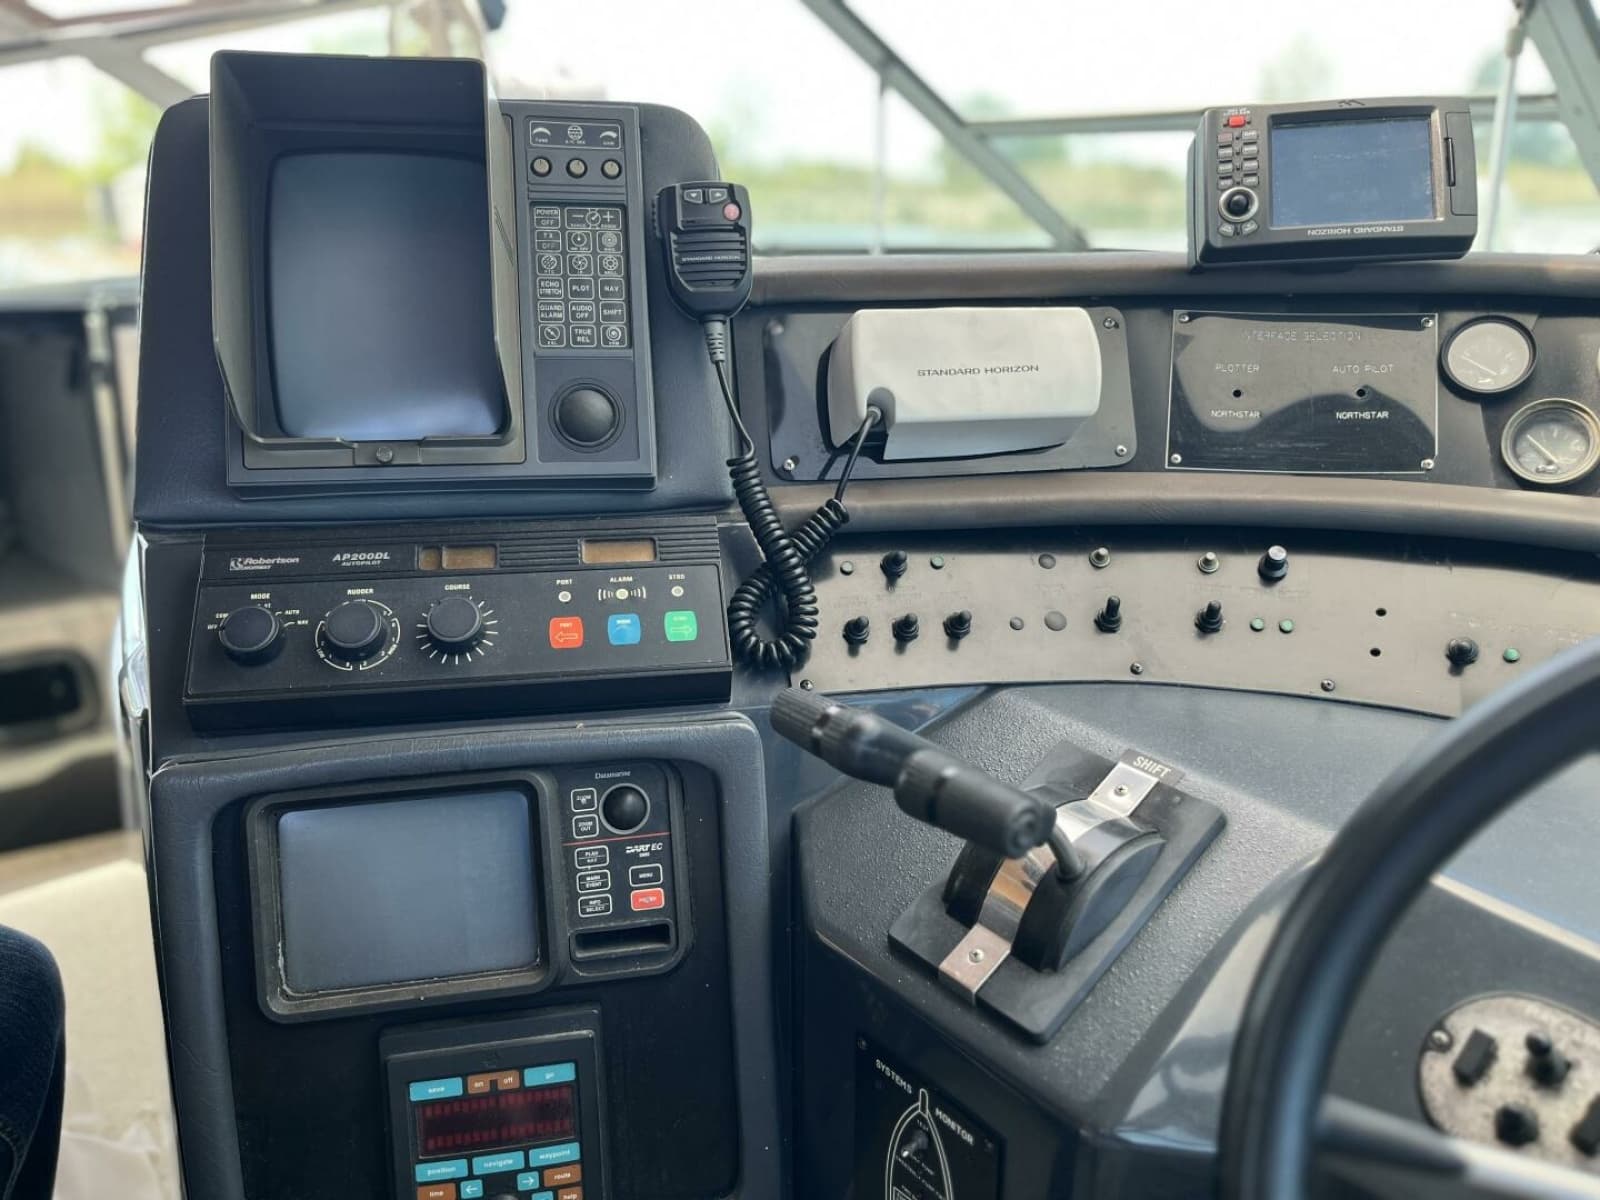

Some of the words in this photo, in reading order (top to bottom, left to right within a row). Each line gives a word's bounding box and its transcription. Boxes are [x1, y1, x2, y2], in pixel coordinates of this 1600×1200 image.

[1307, 227, 1351, 238] HORIZON
[1353, 224, 1404, 235] STANDARD
[917, 366, 981, 377] STANDARD
[984, 363, 1040, 375] HORIZON
[1215, 363, 1260, 374] PLOTTER
[1332, 364, 1360, 375] AUTO
[1364, 364, 1394, 374] PILOT
[1210, 409, 1261, 419] NORTHSTAR
[1336, 410, 1389, 421] NORTHSTAR
[243, 556, 300, 567] Robertson
[331, 552, 391, 562] AP200DL
[341, 560, 381, 568] AUTOPILOT
[444, 583, 471, 591] COURSE
[250, 592, 271, 600] MODE
[1132, 755, 1172, 777] SHIFT
[651, 842, 664, 851] EC
[503, 1075, 514, 1085] off
[875, 1059, 912, 1094] SYSTEMS
[935, 1107, 974, 1146] MONITOR
[539, 1149, 570, 1161] waypoint
[484, 1158, 513, 1168] navigate
[427, 1165, 456, 1176] position
[553, 1172, 572, 1180] route
